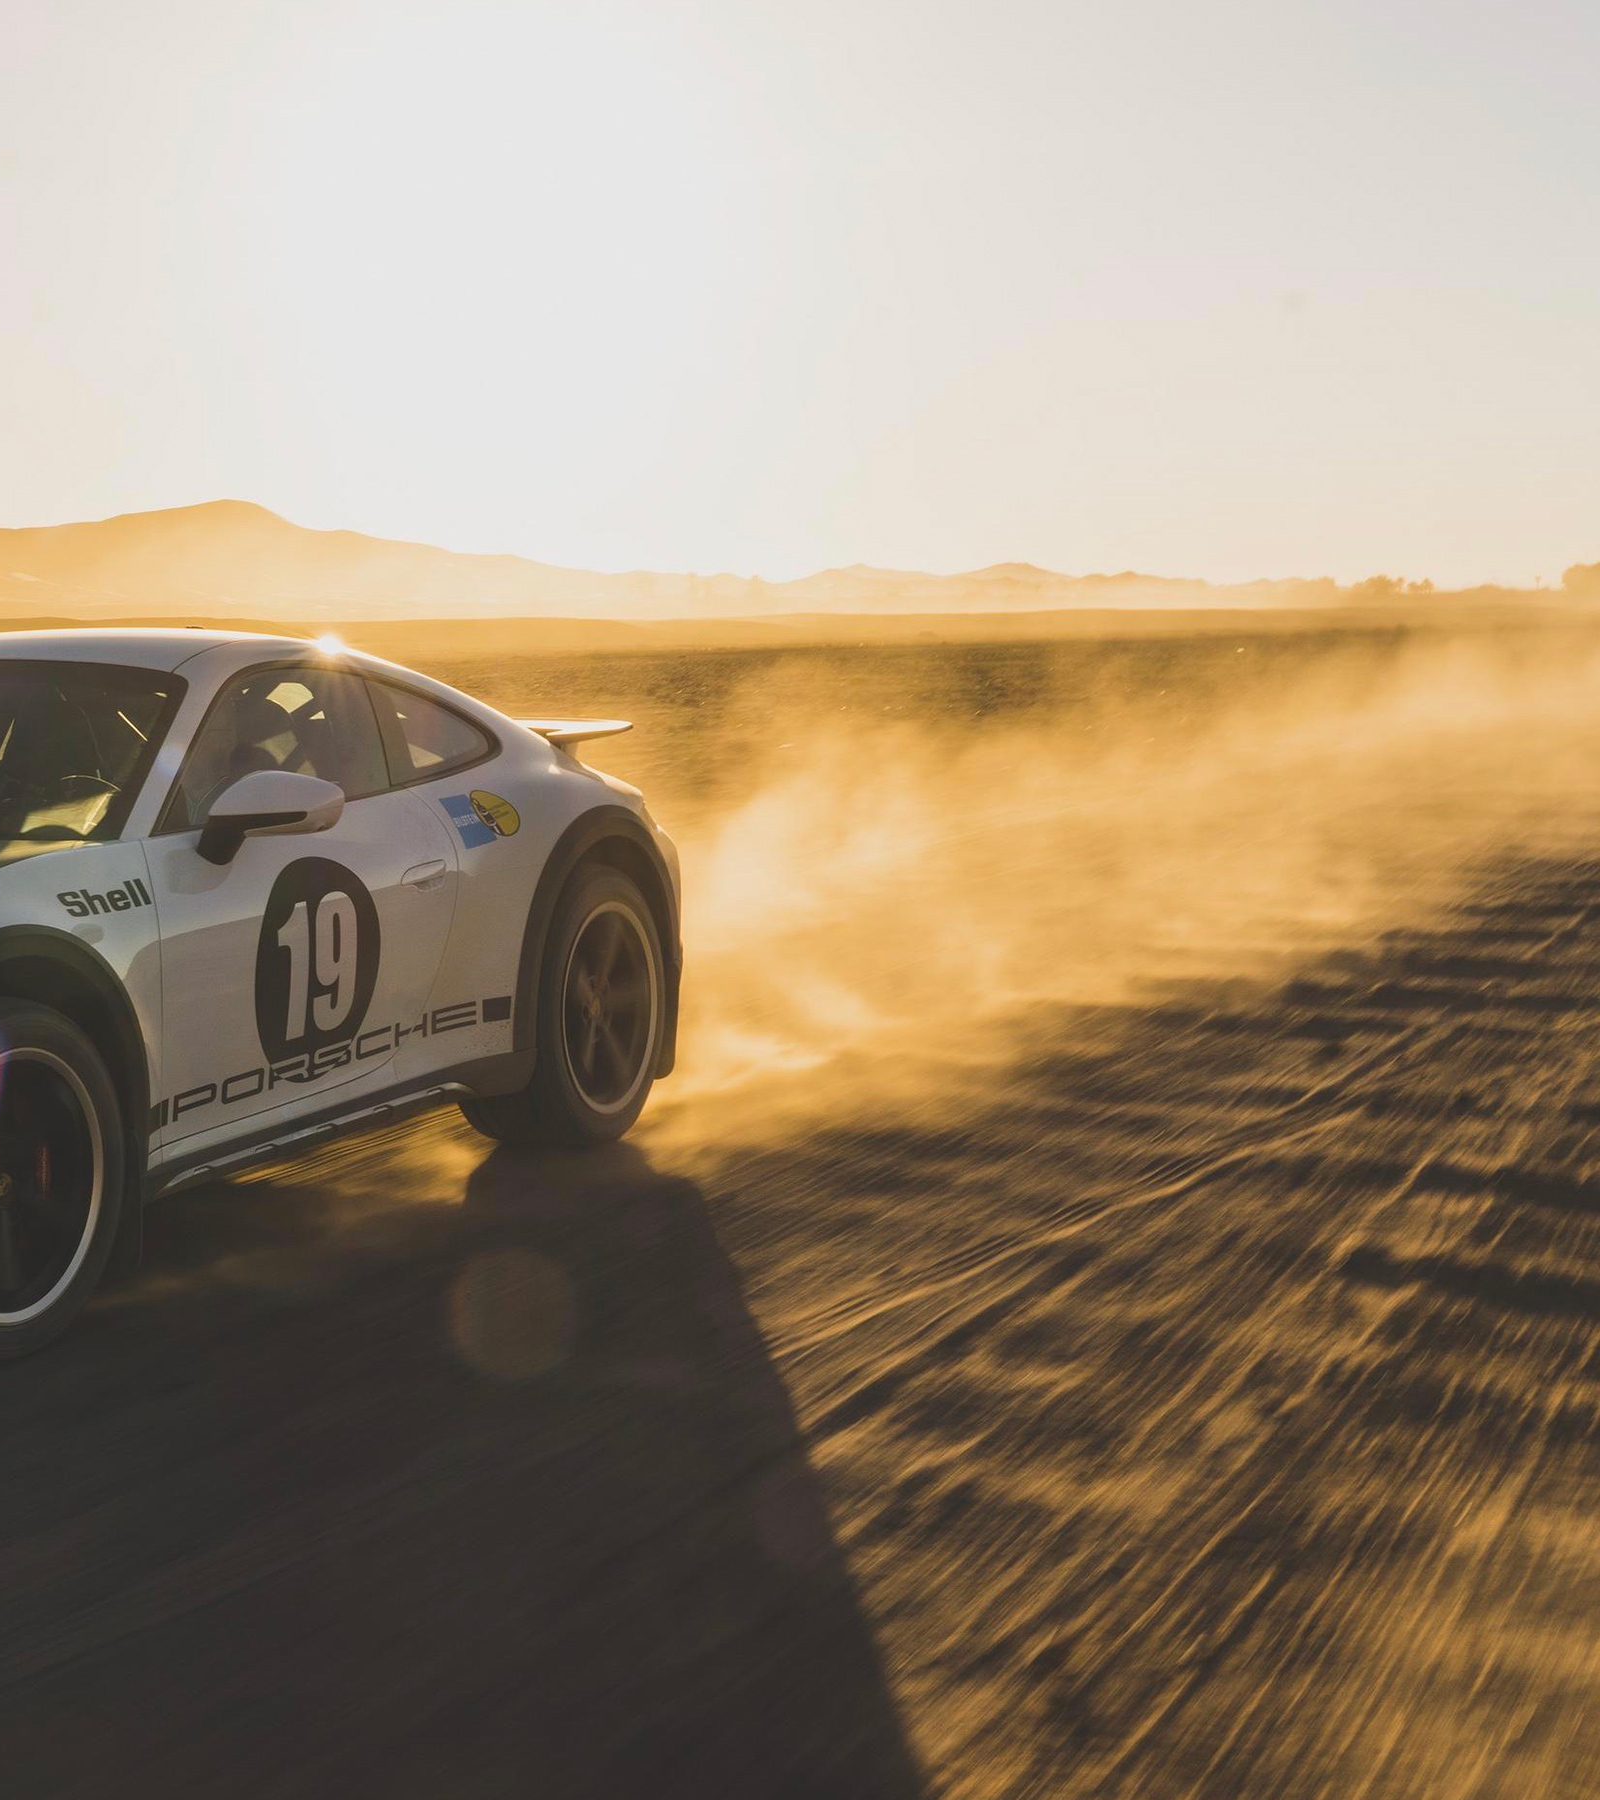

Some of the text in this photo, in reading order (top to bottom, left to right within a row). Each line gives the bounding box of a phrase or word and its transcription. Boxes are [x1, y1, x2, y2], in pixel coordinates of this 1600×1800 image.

[56, 878, 152, 918] Shell
[277, 890, 358, 1042] 19
[172, 1000, 477, 1123] PORSCHE
